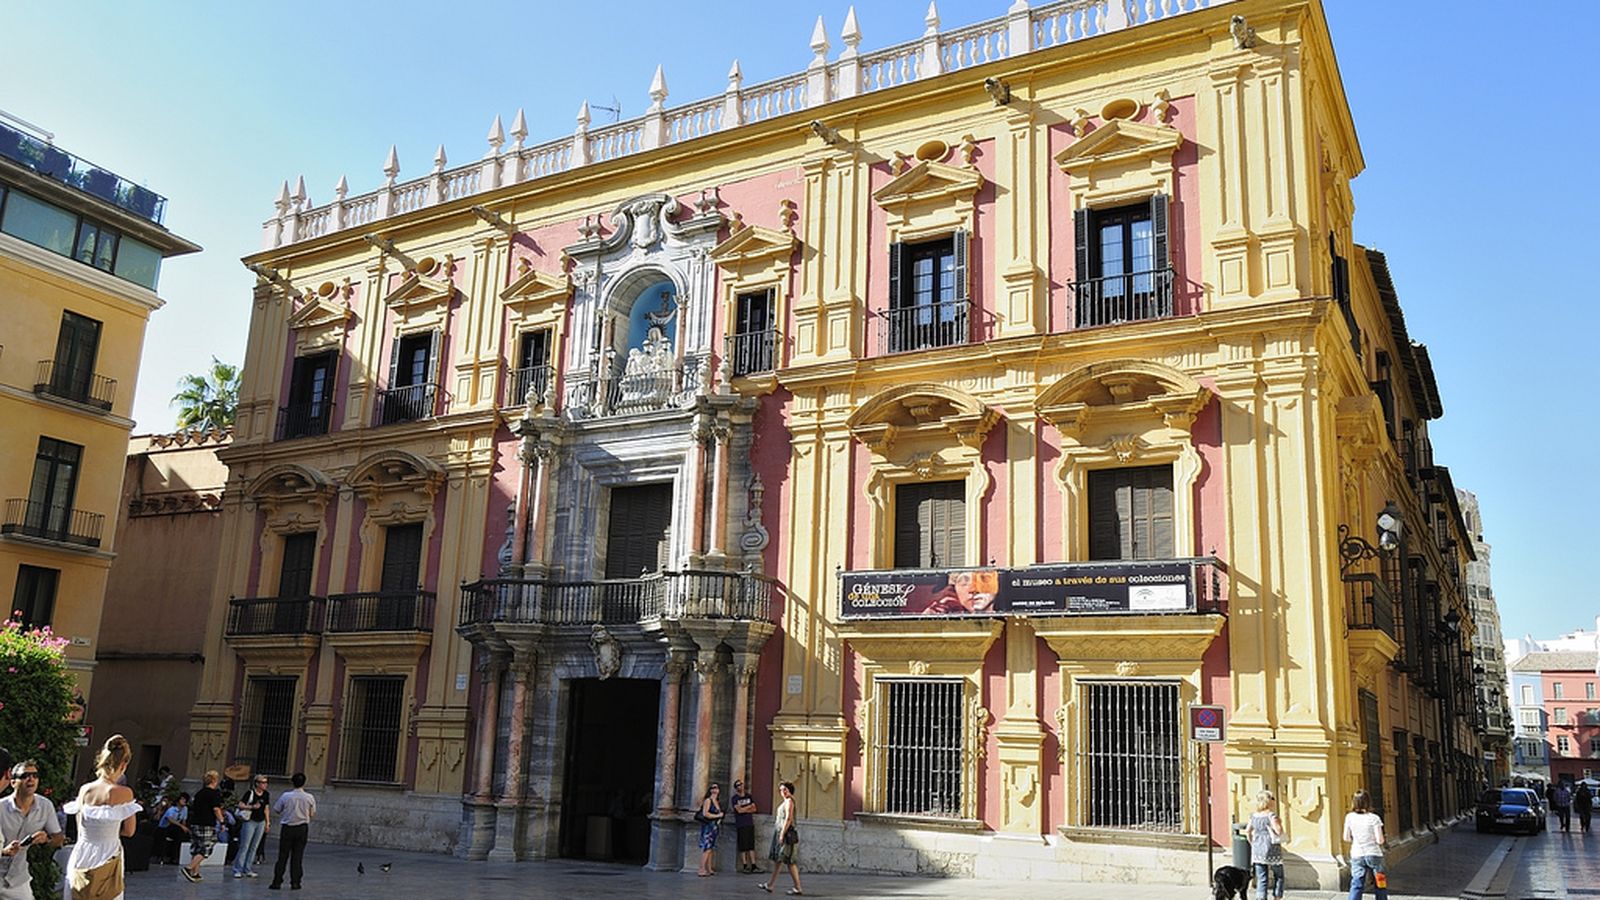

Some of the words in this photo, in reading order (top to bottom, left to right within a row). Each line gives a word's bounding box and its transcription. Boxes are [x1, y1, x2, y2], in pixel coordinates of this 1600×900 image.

[1011, 578, 1020, 587] el
[1022, 578, 1053, 587] museo
[1063, 575, 1093, 585] través
[1095, 575, 1107, 584] de
[1109, 576, 1126, 584] sus
[1128, 574, 1186, 583] colecciones
[852, 595, 908, 607] COLECCIÓN
